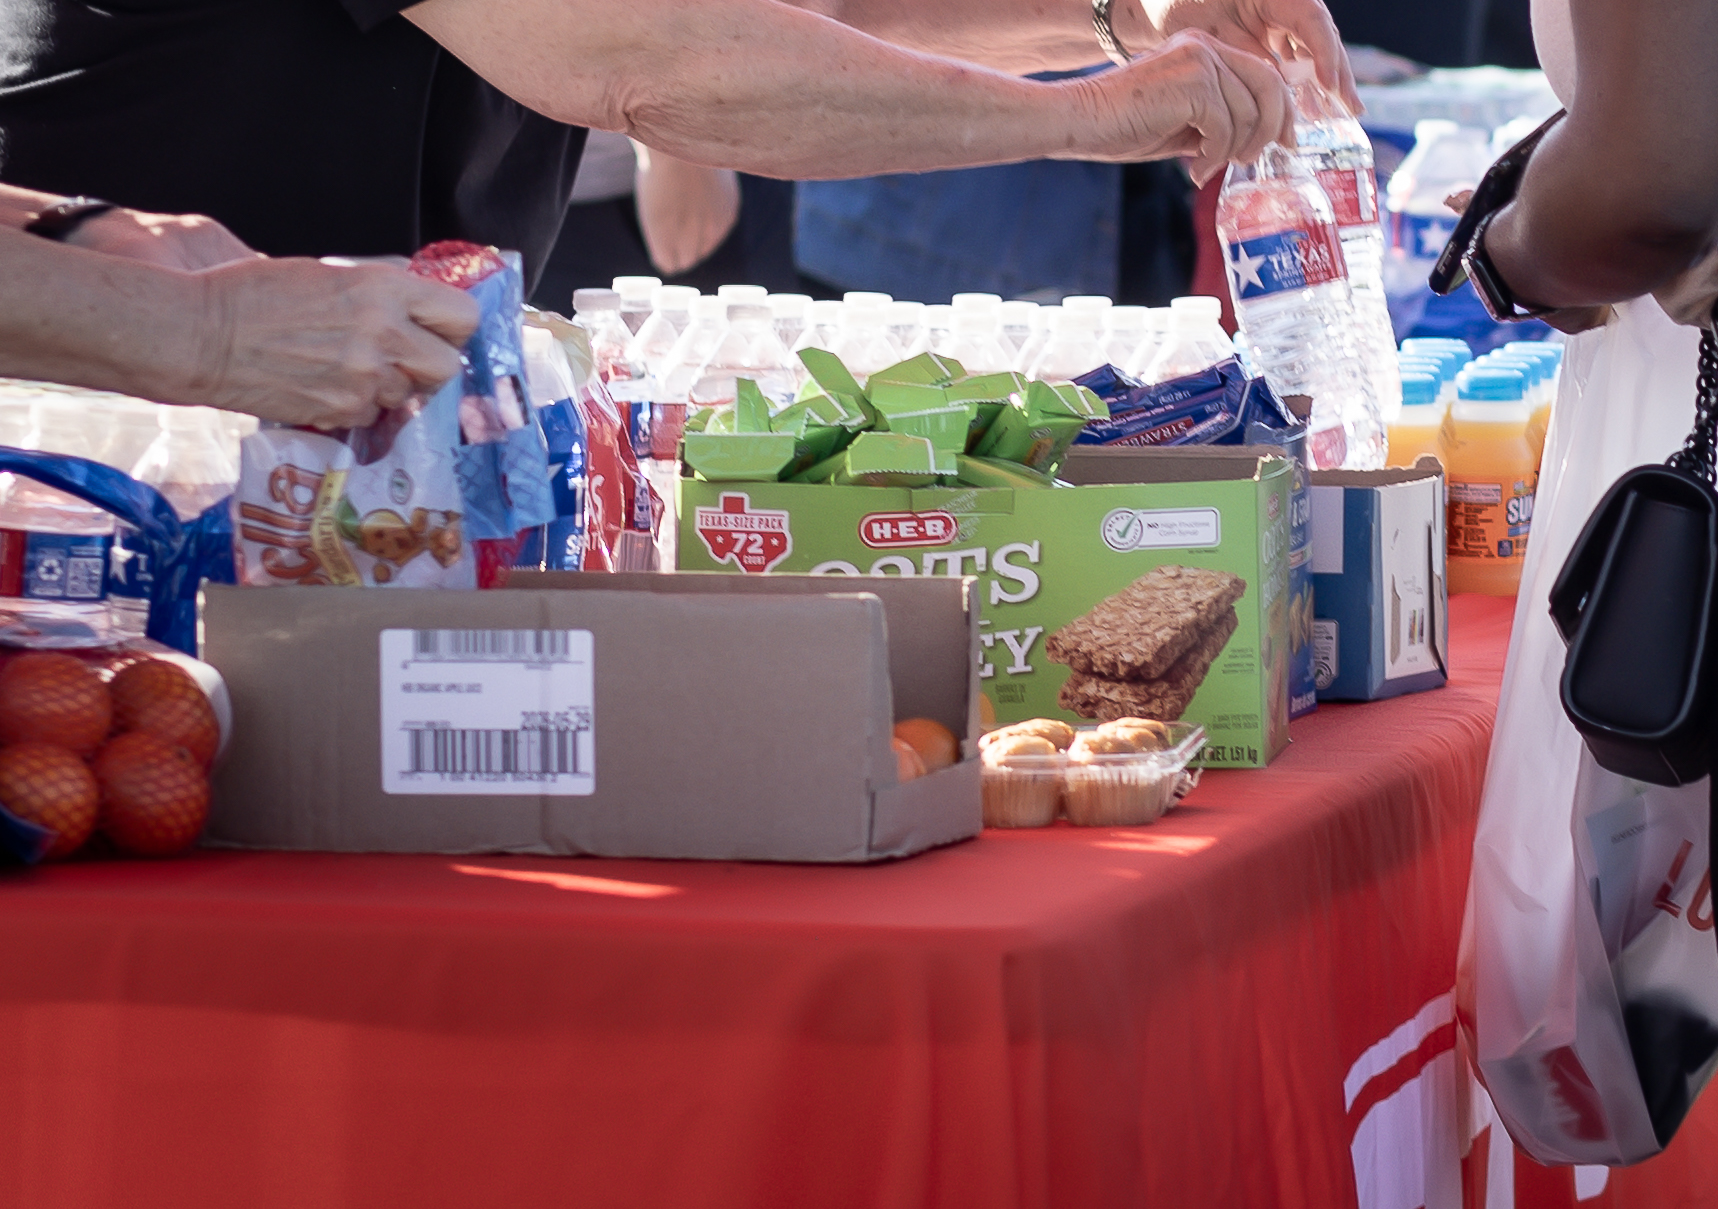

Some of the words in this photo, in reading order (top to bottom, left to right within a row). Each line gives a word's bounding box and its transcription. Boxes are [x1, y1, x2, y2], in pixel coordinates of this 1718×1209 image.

[699, 515, 755, 529] TEXAS-SIZE
[758, 517, 784, 530] PACK
[731, 532, 764, 555] 72
